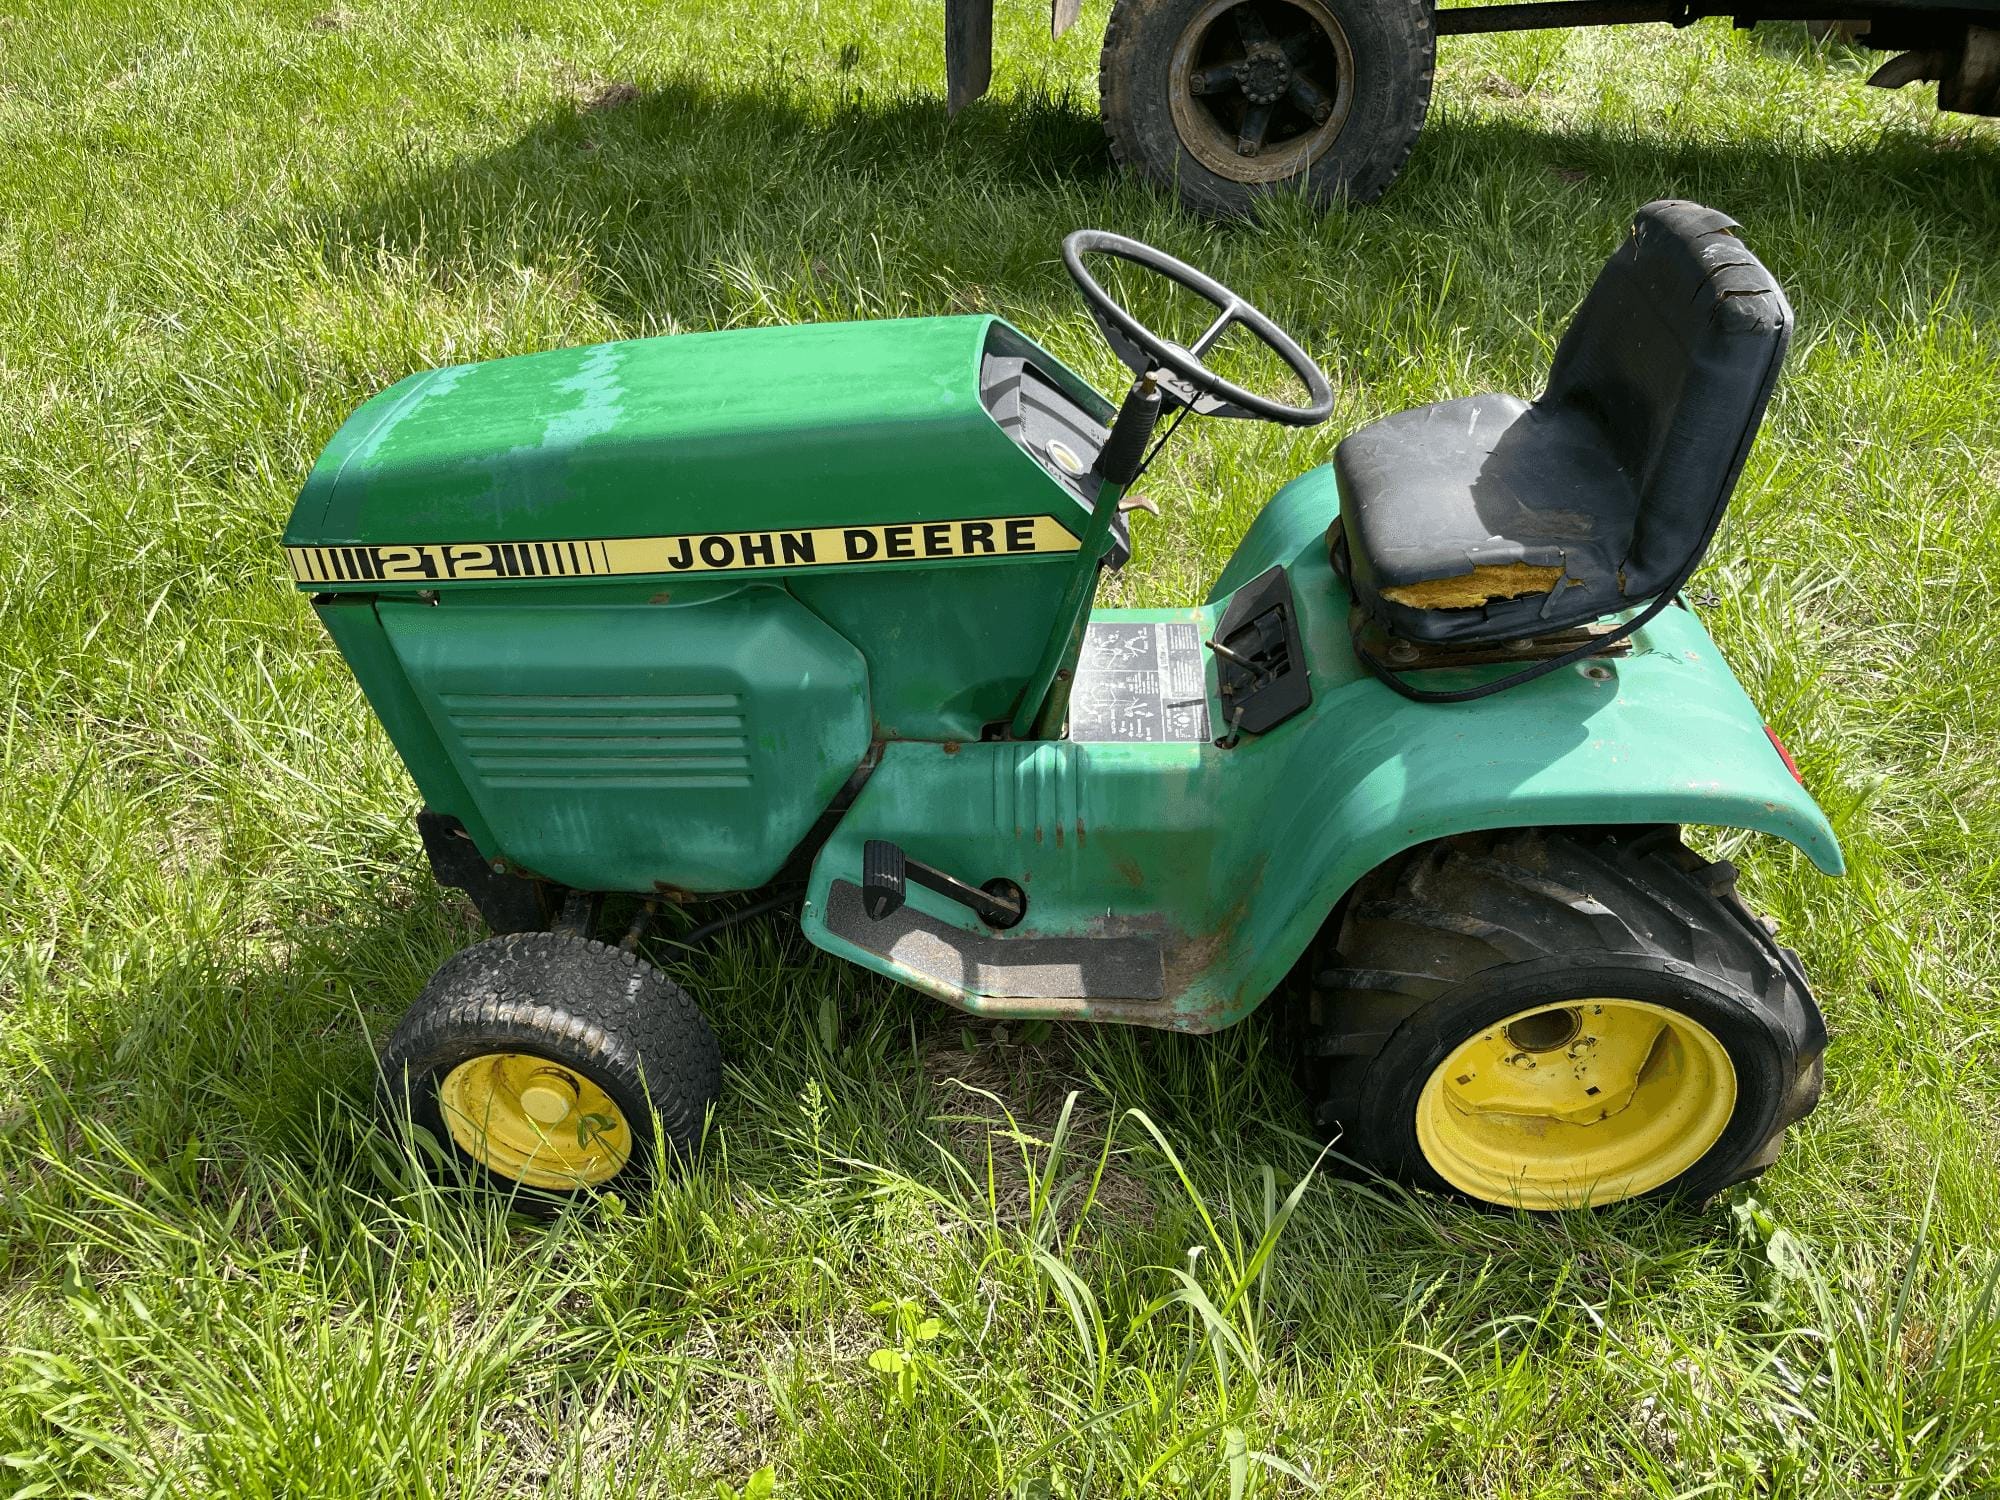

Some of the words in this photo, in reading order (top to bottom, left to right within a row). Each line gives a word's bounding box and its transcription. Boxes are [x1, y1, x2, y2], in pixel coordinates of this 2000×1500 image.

[377, 545, 499, 580] 212
[667, 532, 817, 570] JOHN
[844, 518, 1037, 561] DEERE
